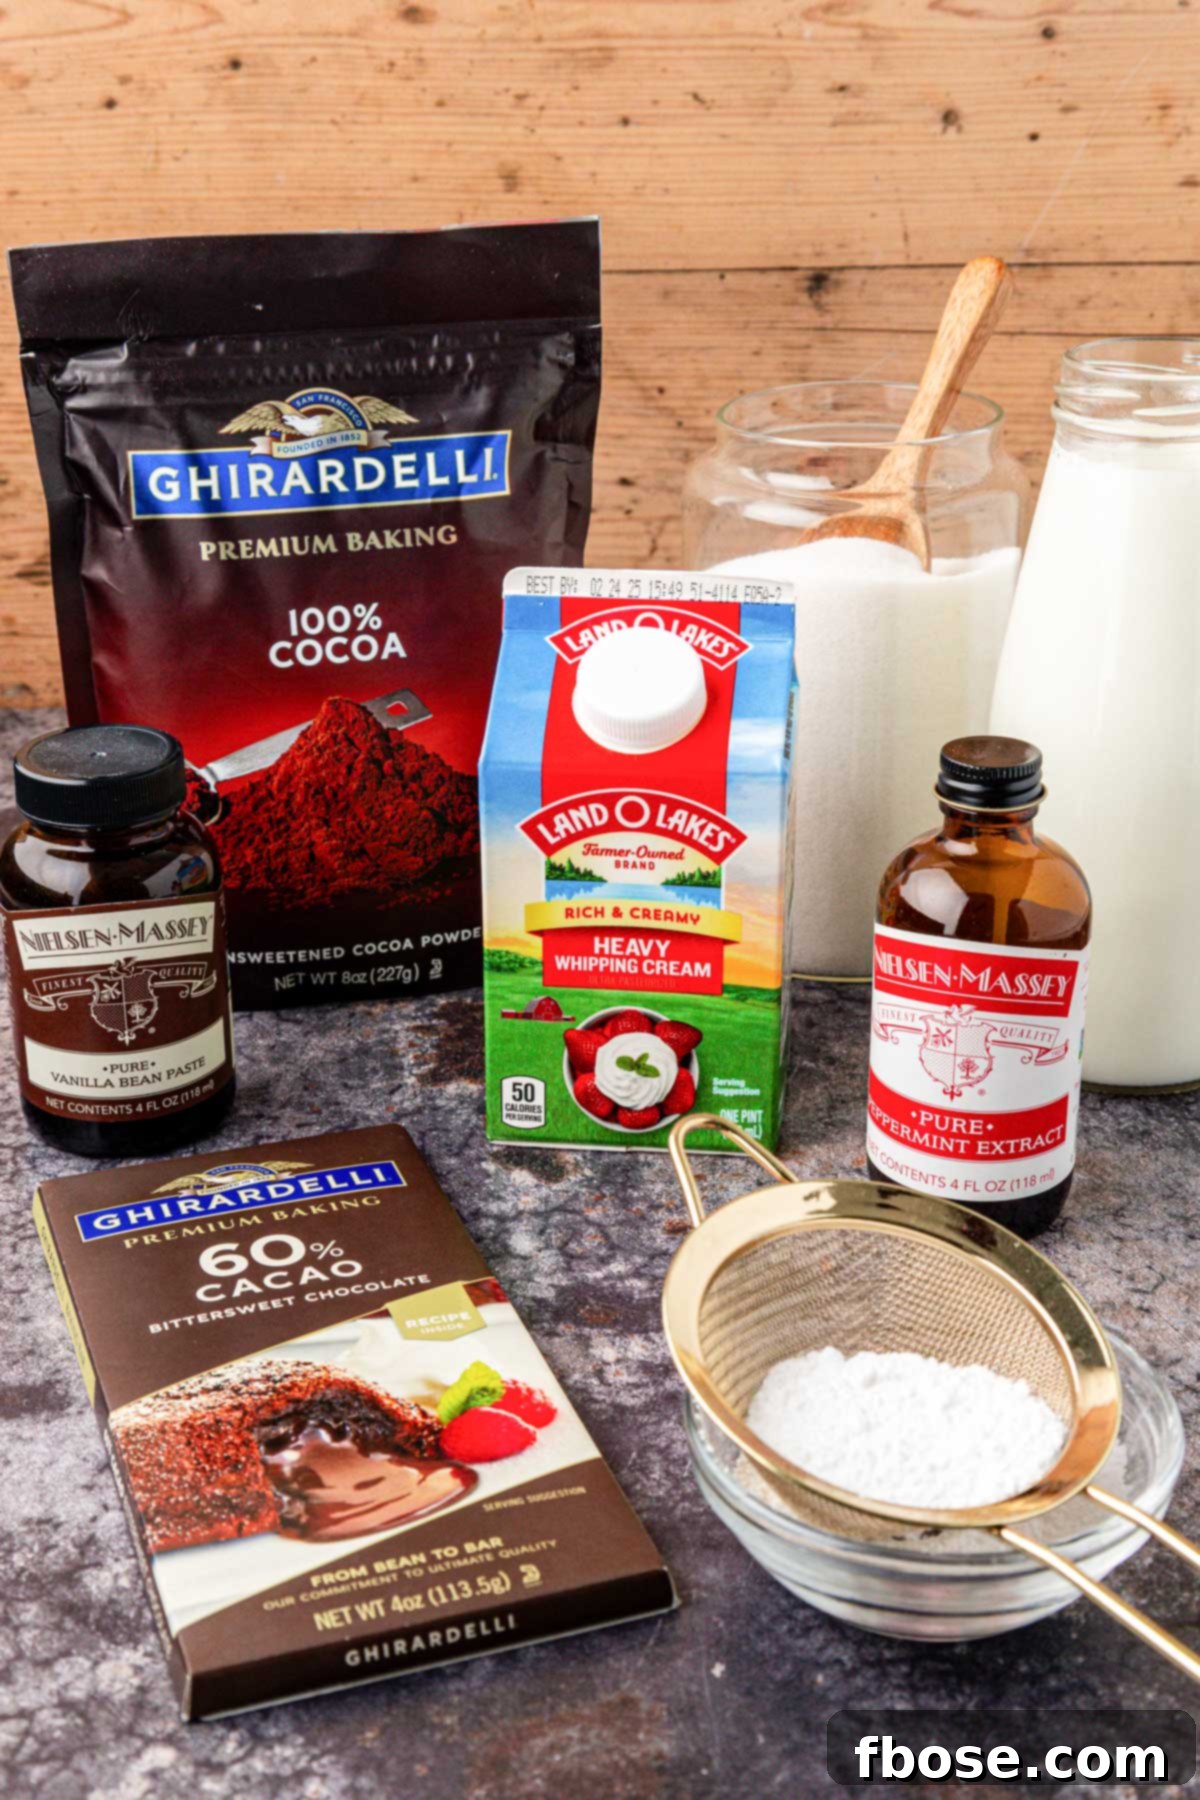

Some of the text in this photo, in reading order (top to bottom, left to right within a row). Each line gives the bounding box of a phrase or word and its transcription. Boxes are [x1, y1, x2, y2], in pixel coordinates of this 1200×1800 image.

[295, 393, 364, 428] SAN FRANCISCO
[277, 432, 362, 454] FOUNDED IN 1852
[147, 446, 494, 502] GHIRARDELLI
[199, 524, 458, 562] PREMIUM BAKING
[525, 574, 555, 595] BEST
[560, 576, 578, 597] BY:
[590, 577, 602, 597] 02
[608, 578, 621, 598] 24
[627, 578, 641, 599] 25
[648, 579, 683, 600] 15:49
[288, 602, 383, 637] 100%
[268, 632, 407, 669] COCOA
[671, 618, 735, 659] LAKES
[536, 795, 732, 853] LAND O LAKES
[581, 842, 685, 861] Farmer-Owned
[614, 859, 656, 871] BRAND
[565, 905, 700, 926] RICH & CREAMY
[227, 926, 482, 964] NSWEETENED COCOA POWDE
[593, 936, 671, 958] HEAVY
[41, 966, 204, 992] FINEST QUALITY
[273, 972, 306, 992] NET
[310, 972, 338, 985] WT
[554, 954, 712, 978] WHIPPING CREAM
[880, 1008, 1054, 1044] FINEST QUALITY
[51, 1056, 206, 1089] VANILLA BEAN PASTE
[45, 1096, 65, 1110] NET
[67, 1098, 133, 1116] CONTENTS
[135, 1103, 143, 1113] 4
[146, 1100, 160, 1111] FL
[161, 1094, 179, 1107] OZ
[181, 1087, 202, 1105] (118
[504, 1103, 543, 1115] CALORIES
[511, 1082, 535, 1103] 50
[740, 1109, 763, 1124] PINT
[869, 1102, 1065, 1156] EPPERMINT EXTRACT
[879, 1151, 947, 1189] CONTENTS
[950, 1178, 959, 1190] 4
[964, 1179, 981, 1193] FL
[984, 1179, 1007, 1193] OZ
[1010, 1171, 1038, 1193] (118
[92, 1166, 388, 1231] GHIRARDELLI
[123, 1194, 382, 1250] PREMIUM BAKING
[198, 1233, 345, 1278] 60%
[194, 1259, 363, 1303] CACAO
[148, 1273, 431, 1335] BITTERSWEET CHOCOLATE
[404, 1311, 472, 1329] RECIPE
[482, 1485, 587, 1512] SERVING SUGGESTION
[262, 1538, 559, 1611] OUR COMMITMENT TO ULTIMATE QUALITY
[309, 1536, 504, 1590] FROM BEAN TO BAR
[313, 1570, 512, 1633] NET WT 4oz (113.5g)
[344, 1614, 517, 1669] GHIRARDELLI
